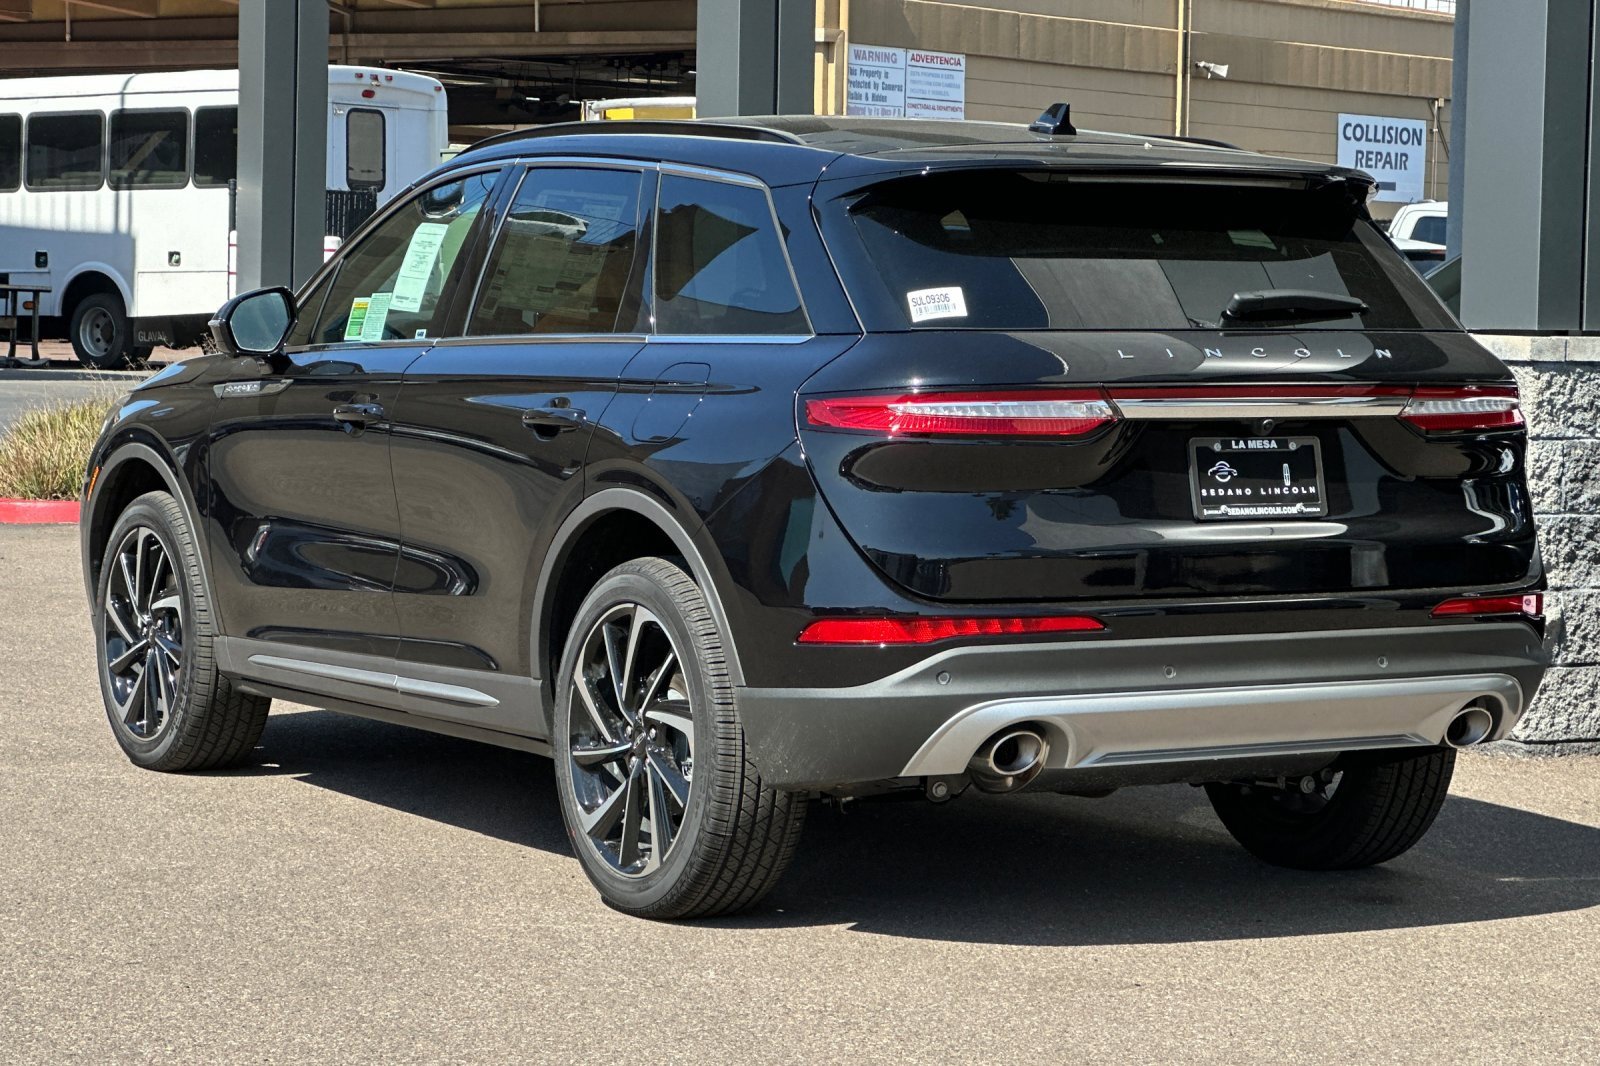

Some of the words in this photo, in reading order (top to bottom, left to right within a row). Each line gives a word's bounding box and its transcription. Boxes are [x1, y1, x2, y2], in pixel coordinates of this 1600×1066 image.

[854, 48, 898, 64] WARNING
[910, 53, 961, 67] ADVERTENCIA
[859, 67, 882, 79] Property
[873, 81, 879, 91] by
[881, 81, 903, 92] Cameras
[848, 91, 862, 101] isible
[871, 93, 887, 102] Hidden
[1343, 122, 1423, 146] COLLISION
[1355, 149, 1409, 171] REPAIR
[911, 293, 951, 307] SUL09306
[1117, 347, 1393, 359] LINCOLN
[1231, 440, 1246, 449] LA
[1248, 439, 1278, 449] MESA
[1201, 488, 1252, 497] SEDANO
[1260, 486, 1316, 495] LINCOLN
